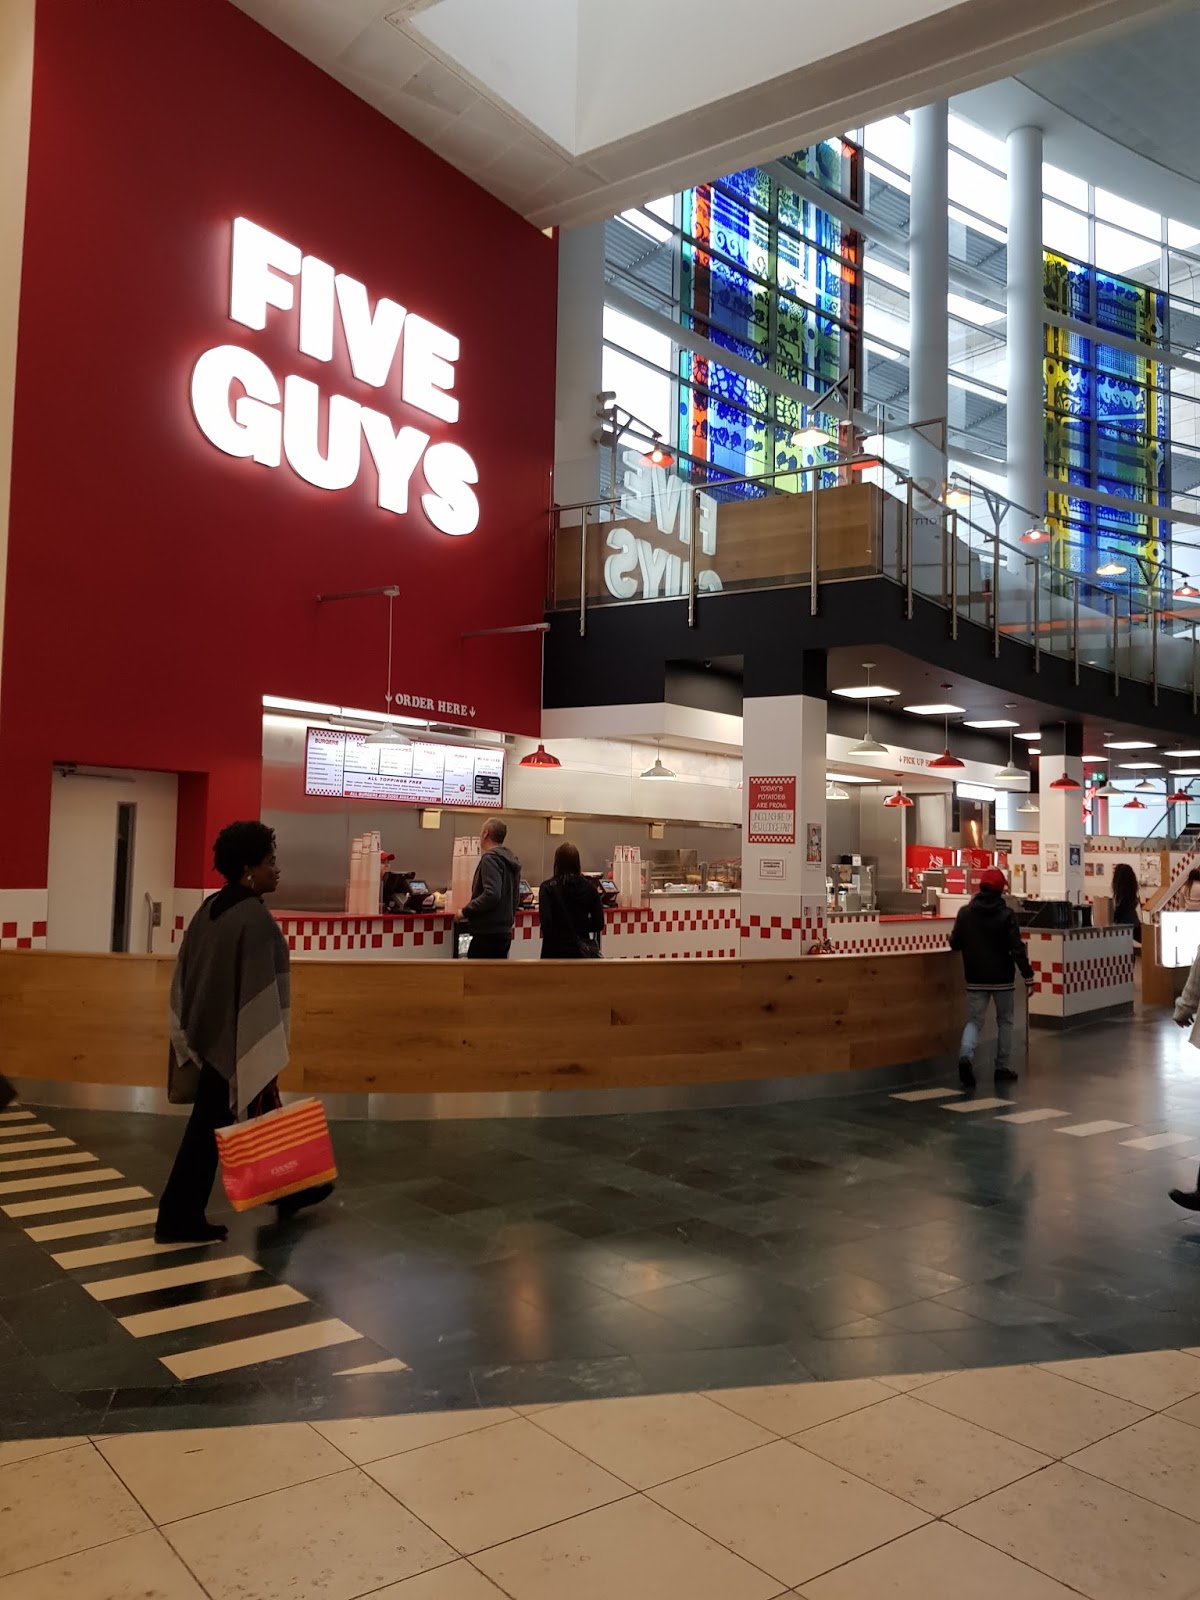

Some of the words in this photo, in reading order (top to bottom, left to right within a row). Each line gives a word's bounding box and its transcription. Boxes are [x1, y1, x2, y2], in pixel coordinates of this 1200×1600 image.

[229, 216, 460, 424] FIVE
[190, 344, 480, 536] GUYS
[395, 693, 435, 711] ORDER
[438, 700, 468, 716] HERE
[314, 738, 339, 746] BURGERS
[903, 756, 916, 765] PICK
[917, 758, 924, 767] UP
